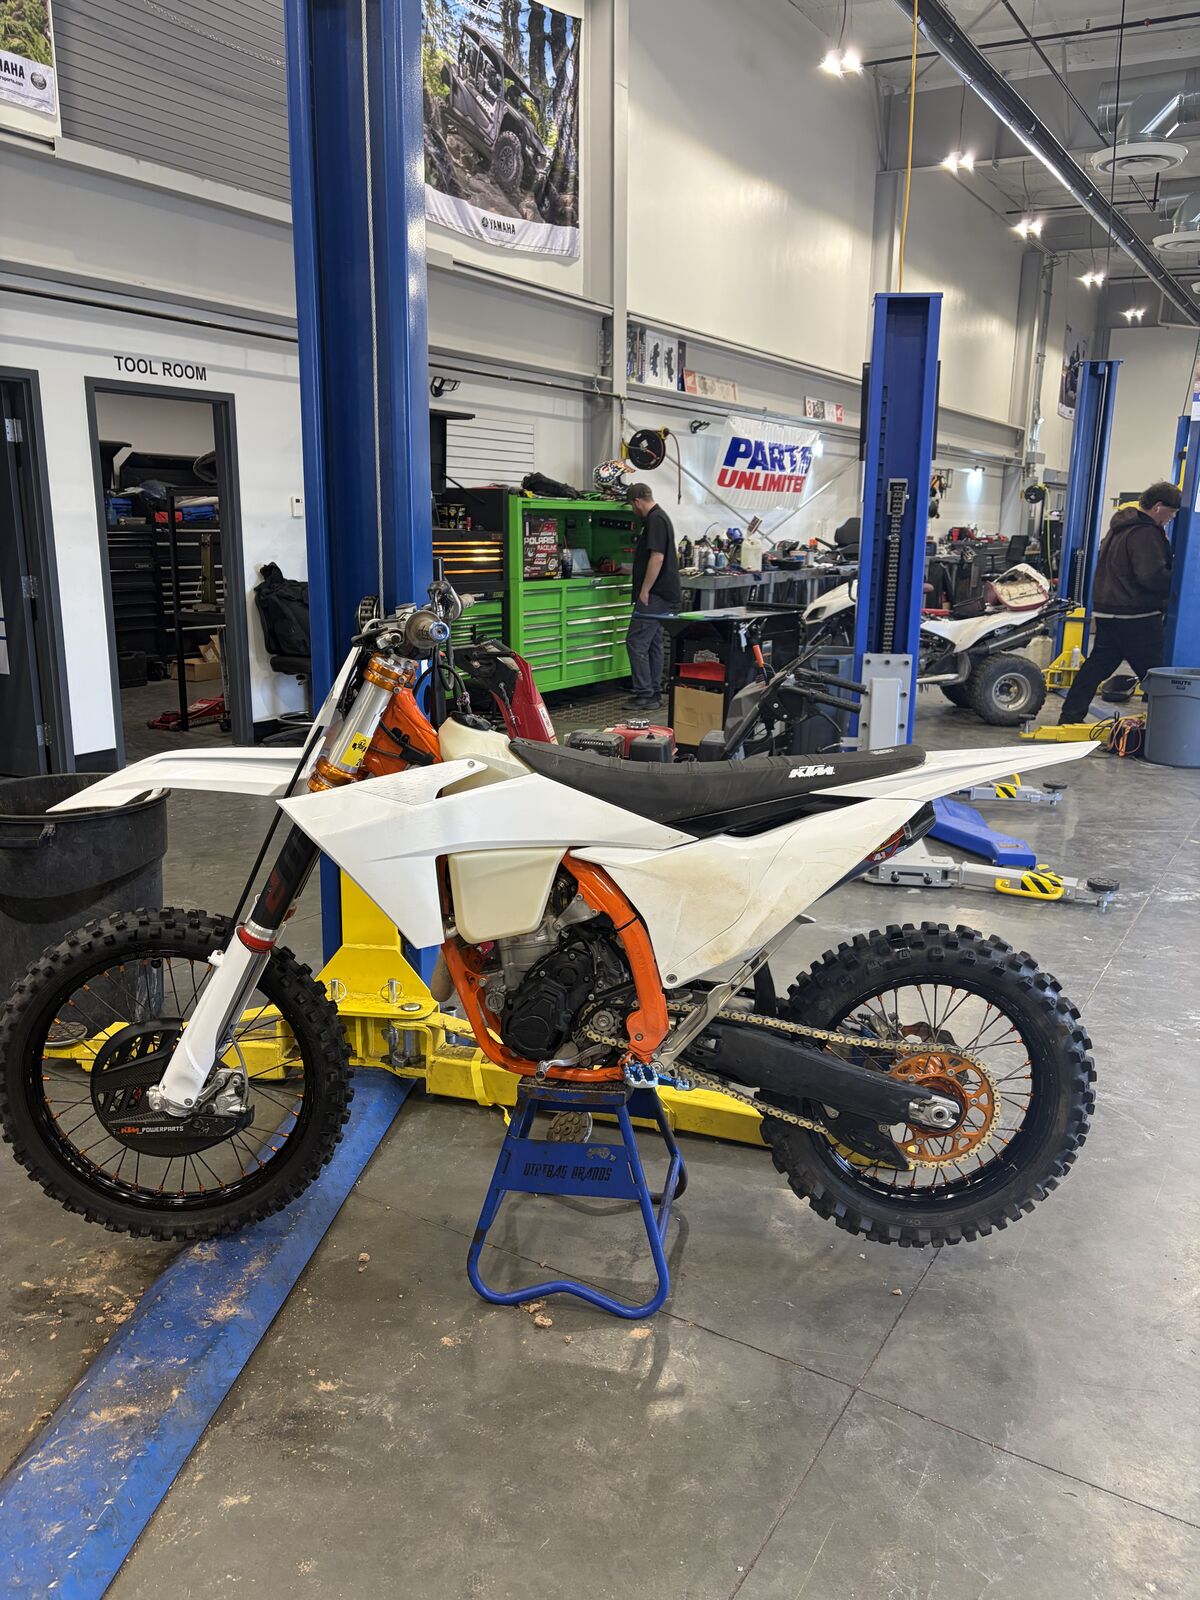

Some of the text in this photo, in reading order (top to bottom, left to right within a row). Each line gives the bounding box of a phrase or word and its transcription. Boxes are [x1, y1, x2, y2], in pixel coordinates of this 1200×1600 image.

[0, 59, 25, 79] AHA
[489, 218, 516, 235] YAMAHA
[113, 355, 207, 381] TOOL ROOM
[523, 536, 554, 545] POLARIS
[788, 763, 836, 778] KTM
[120, 1125, 184, 1135] KTM POWERPARTS
